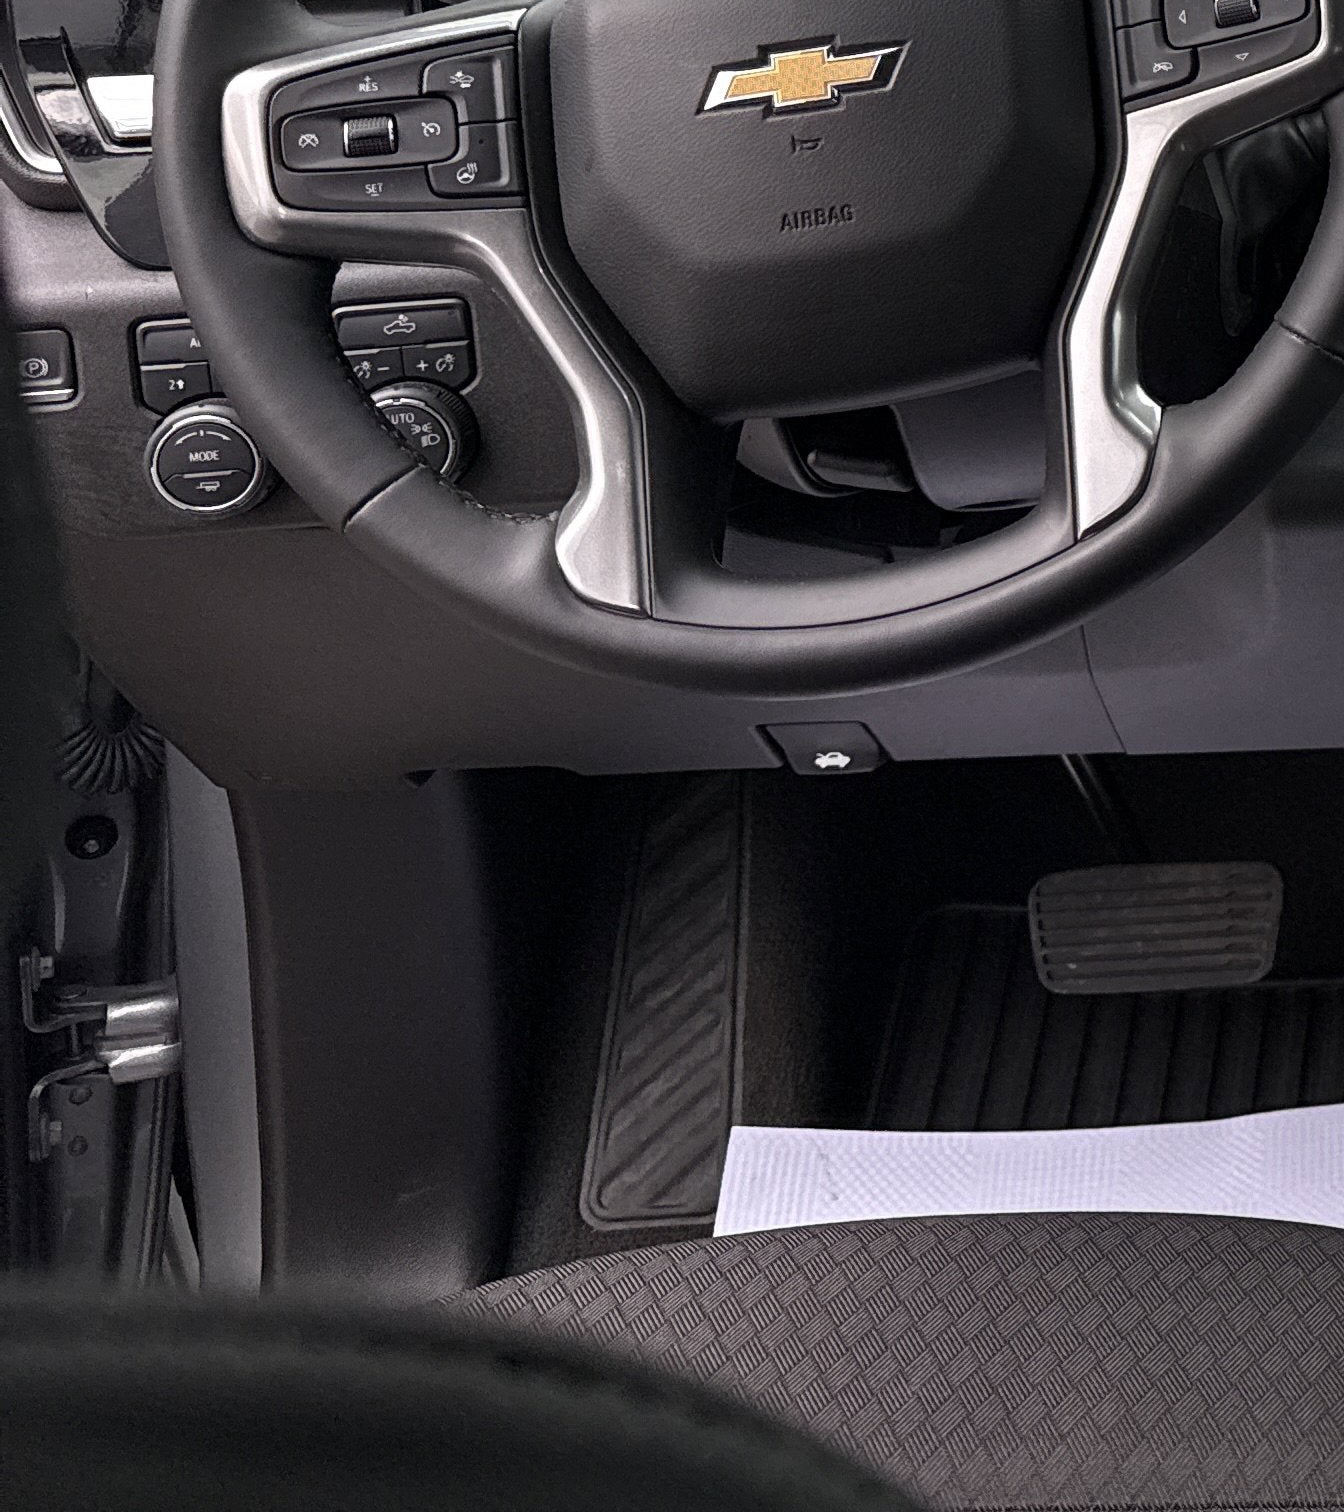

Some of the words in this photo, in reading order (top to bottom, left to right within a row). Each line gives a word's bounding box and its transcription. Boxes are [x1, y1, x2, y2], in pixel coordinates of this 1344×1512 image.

[358, 82, 379, 93] RES
[365, 182, 384, 194] SET
[780, 204, 853, 232] AIRBAG
[386, 413, 415, 425] UTO
[188, 449, 220, 463] MODE
